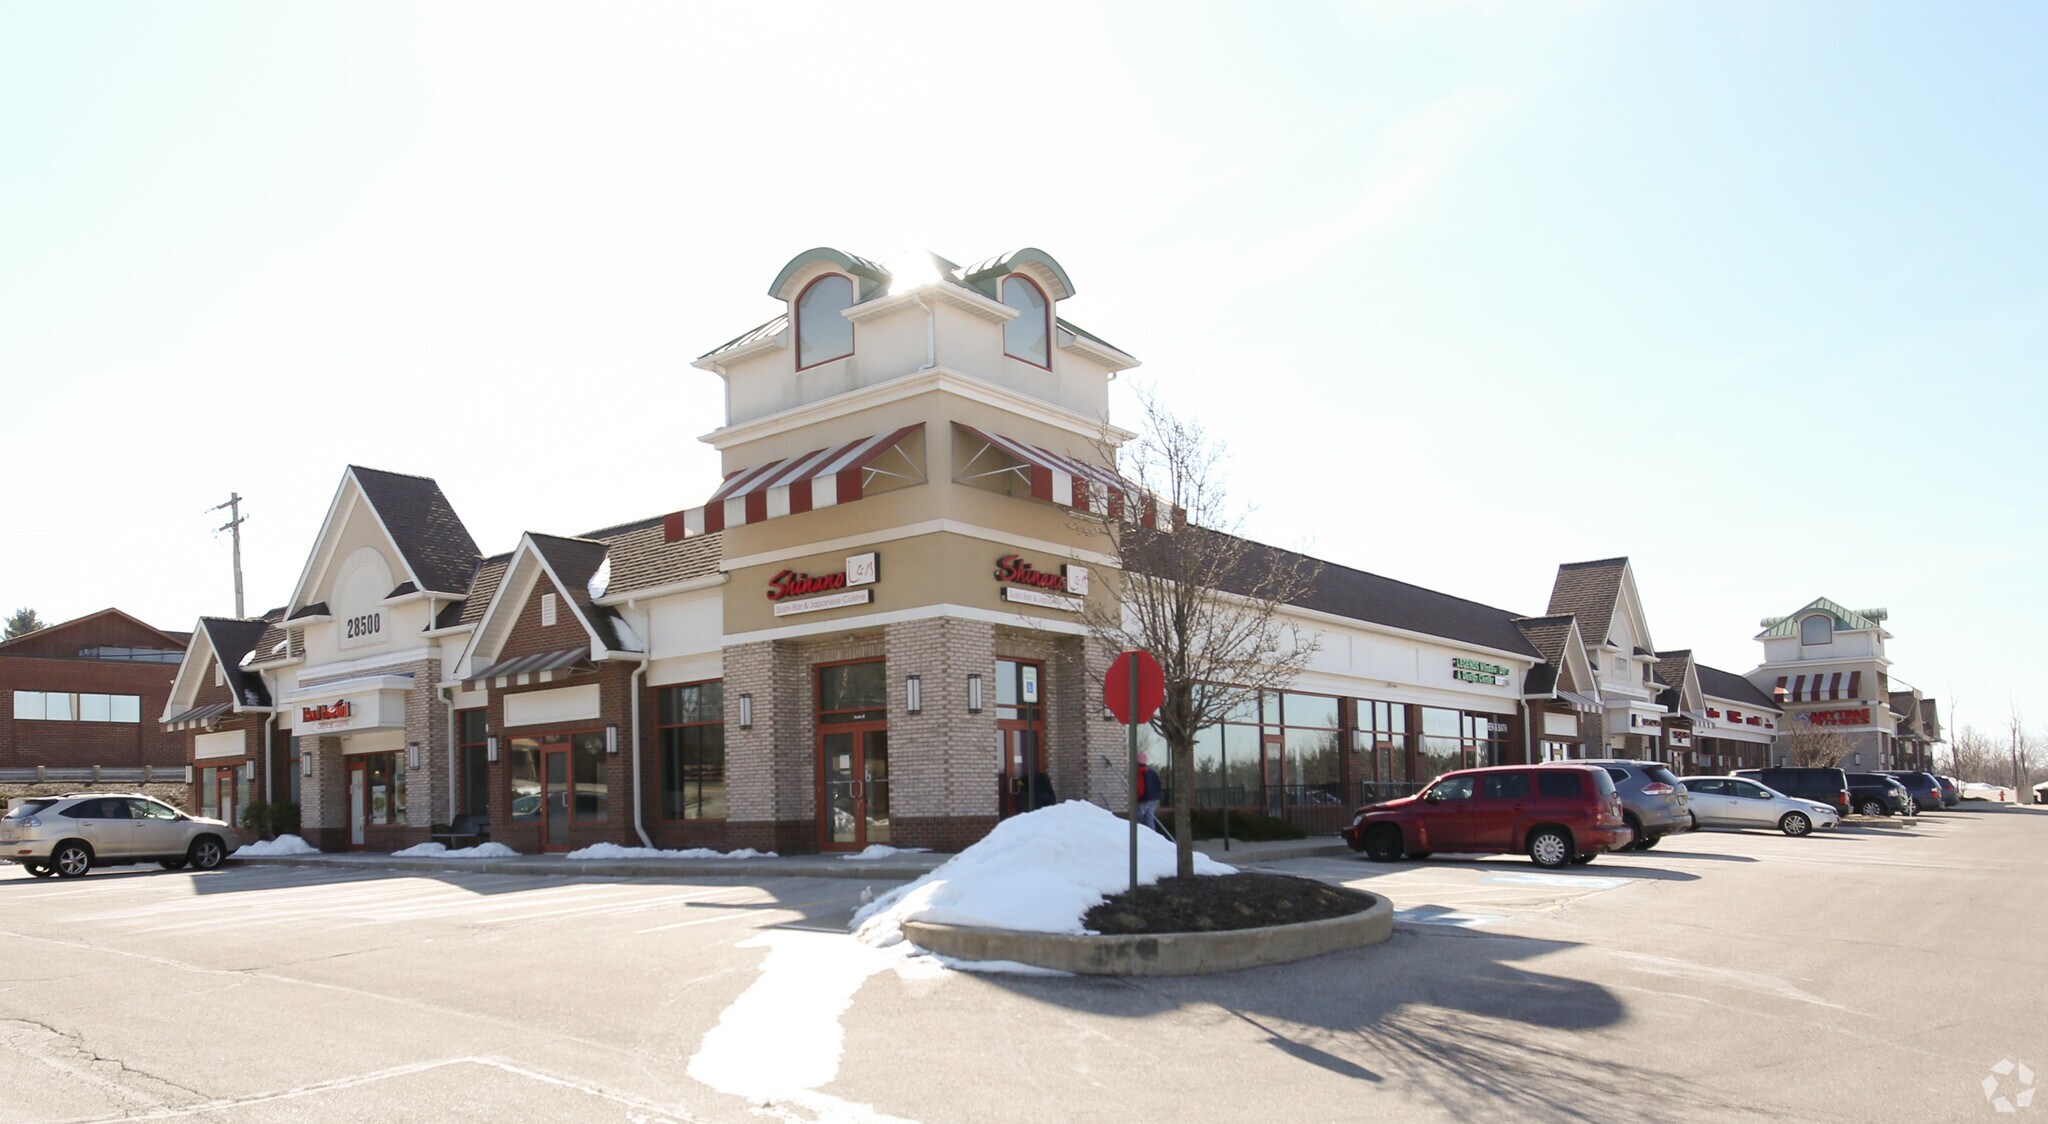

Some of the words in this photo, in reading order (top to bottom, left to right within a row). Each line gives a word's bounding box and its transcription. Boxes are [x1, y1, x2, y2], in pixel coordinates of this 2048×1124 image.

[767, 569, 846, 600] Shinano
[792, 603, 802, 611] Bar
[811, 598, 841, 609] Japanese
[842, 593, 867, 604] Cuisine
[347, 613, 380, 639] 28500
[1456, 658, 1480, 671] LEGENDS
[1810, 708, 1870, 721] ANYTIME
